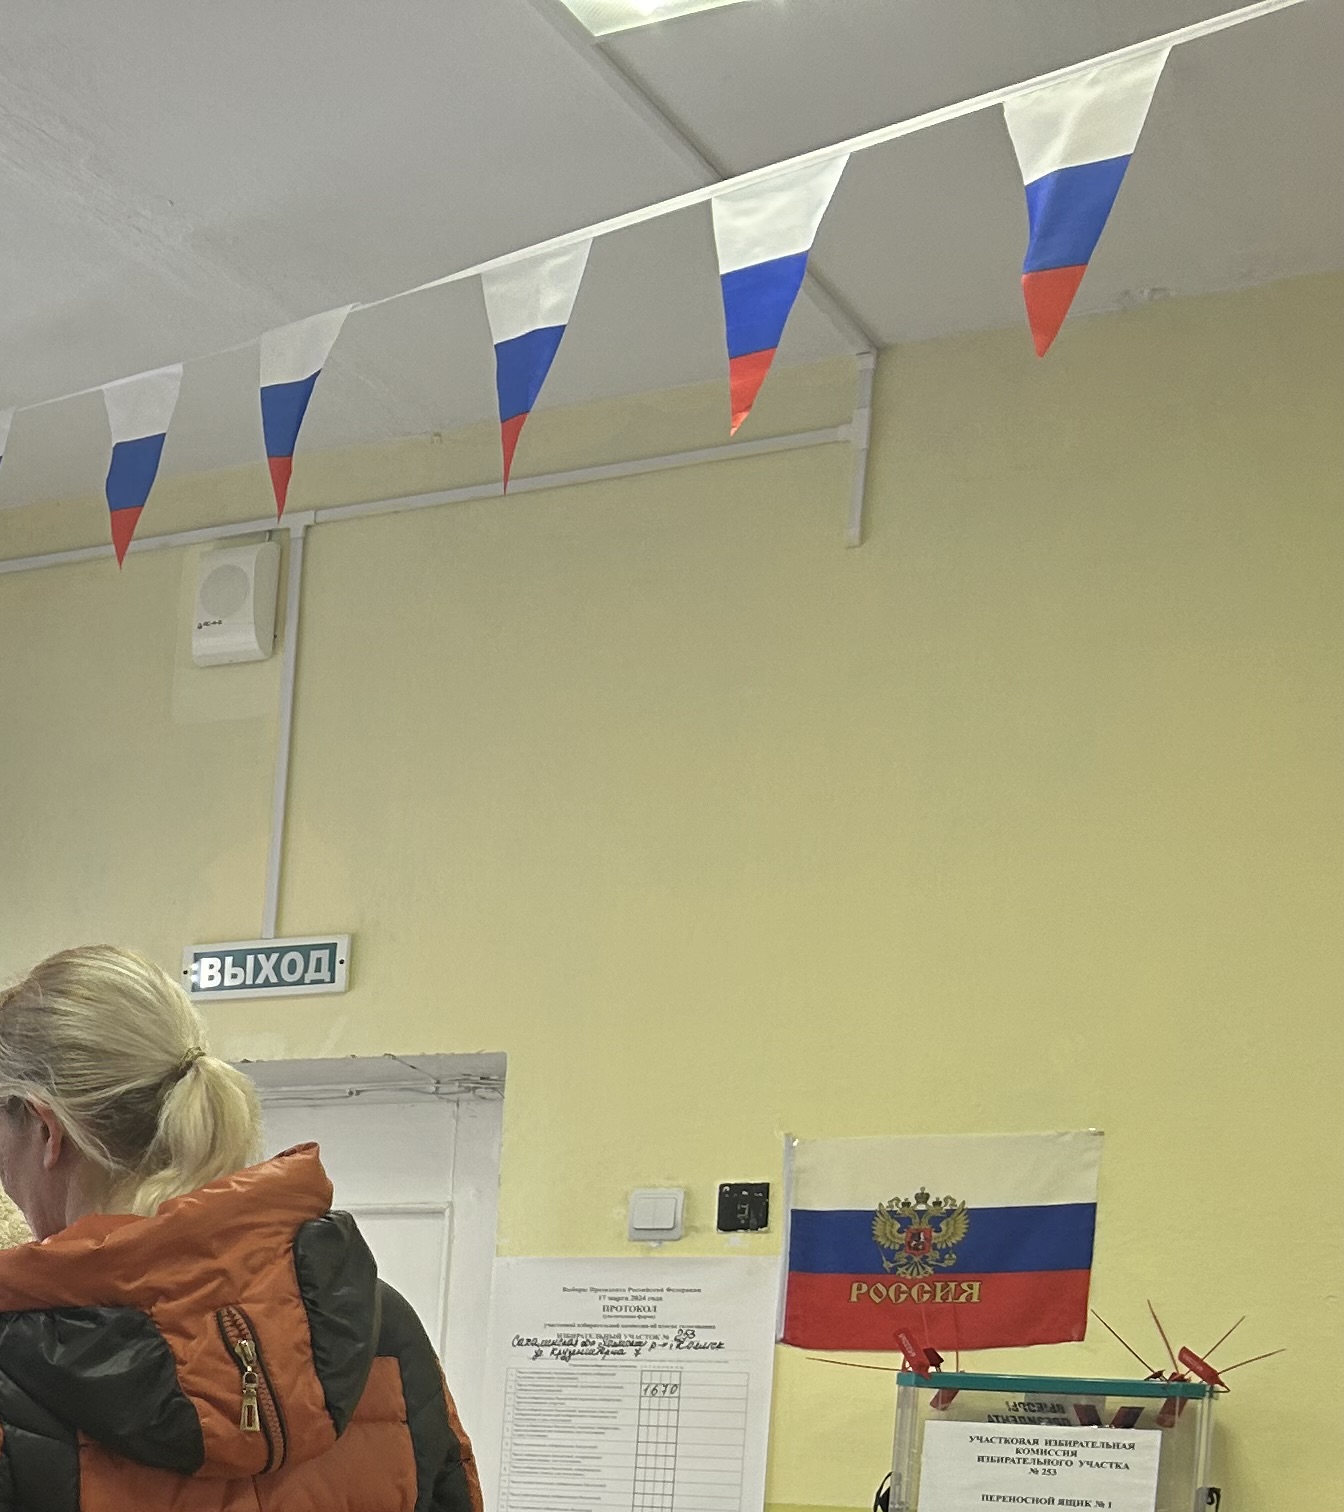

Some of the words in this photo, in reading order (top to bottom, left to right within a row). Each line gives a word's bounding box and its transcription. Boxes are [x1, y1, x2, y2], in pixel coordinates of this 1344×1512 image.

[200, 949, 331, 989] ВЫХОД
[848, 1281, 982, 1304] РОССИЯ
[602, 1304, 658, 1314] ПРОТОКОЛ
[968, 1434, 1040, 1446] УЧАСТКОВАЯ
[1044, 1438, 1136, 1451] ИЗБИРАТЕЛЬНАЯ
[1015, 1447, 1078, 1458] КОМИССИЯ
[976, 1455, 1074, 1467] ИЗБИРАТЕЛЬНОГО
[1078, 1460, 1130, 1471] УЧАСТКА
[1028, 1467, 1039, 1475] №
[1041, 1467, 1057, 1476] 253
[981, 1493, 1055, 1506] ПЕРЕНОСНОЙ
[1057, 1498, 1092, 1508] ЯЩИК
